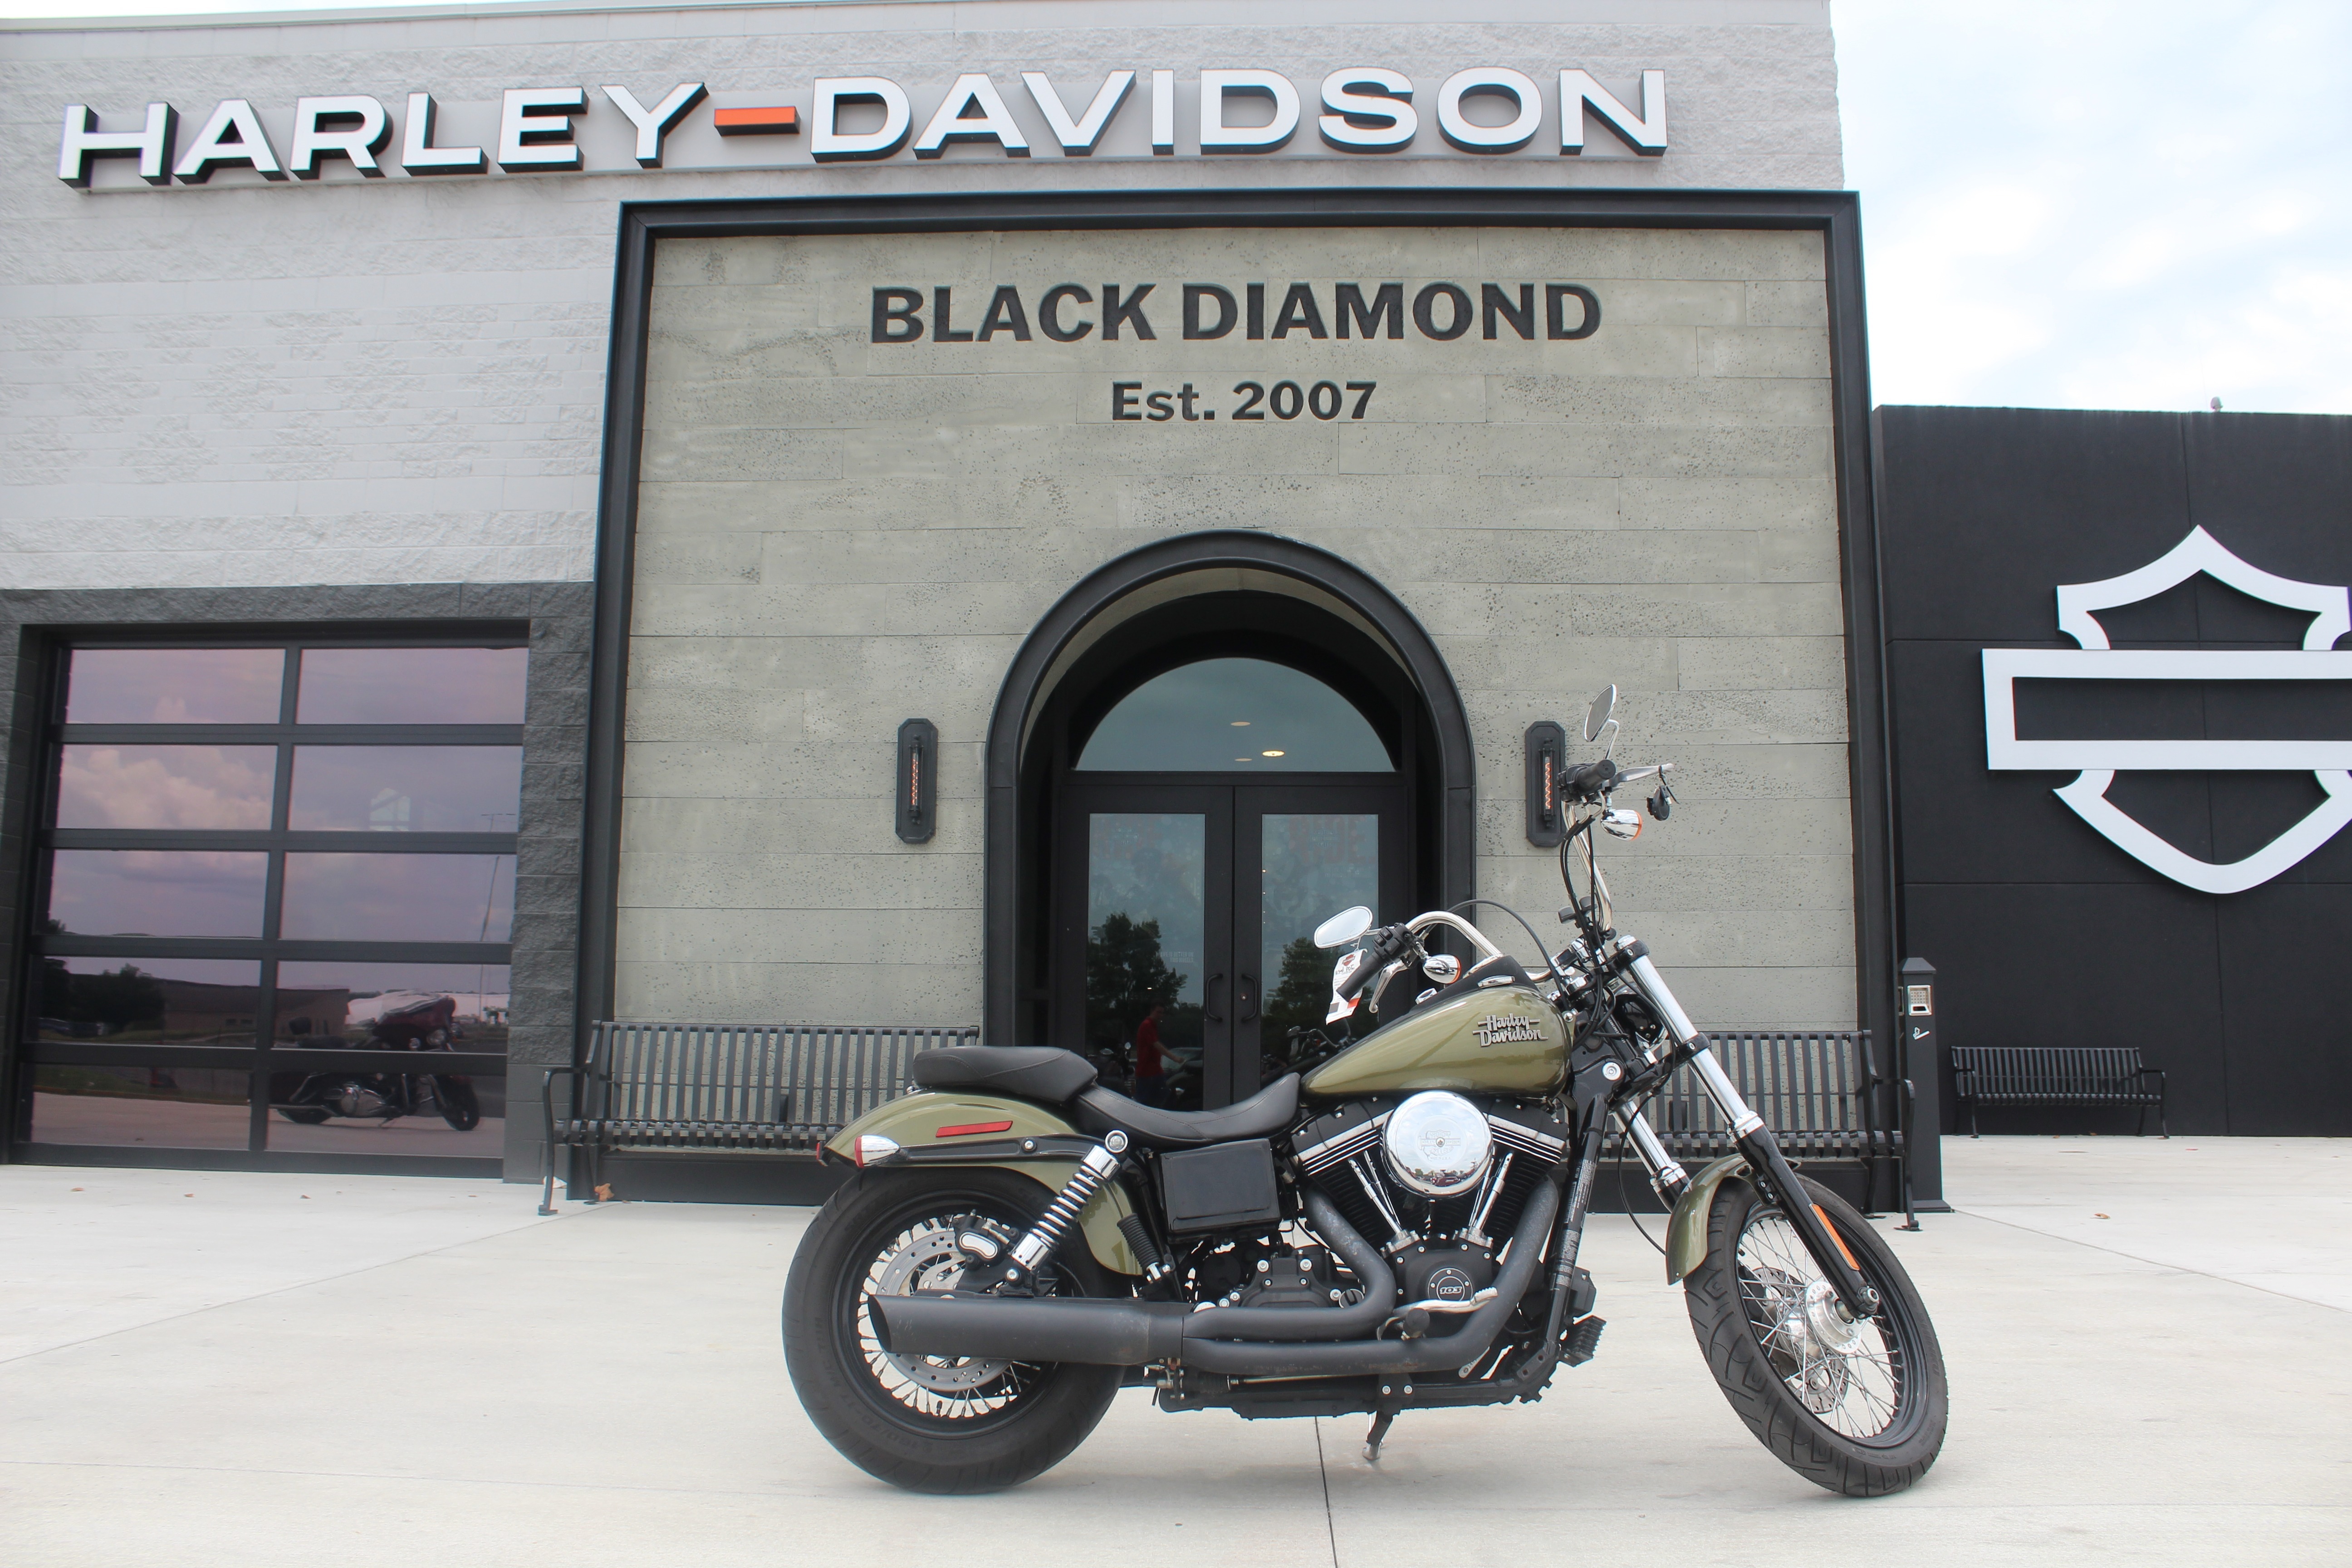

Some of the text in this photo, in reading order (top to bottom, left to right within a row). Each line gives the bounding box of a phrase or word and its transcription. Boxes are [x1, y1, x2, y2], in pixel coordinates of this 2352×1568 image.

[58, 67, 1667, 188] HARLEY-DAVIDSON
[871, 282, 1602, 343] BLACK DIAMOND
[1112, 379, 1377, 422] Est. 2007
[1473, 1026, 1548, 1047] Davidson
[1440, 1286, 1462, 1294] 103
